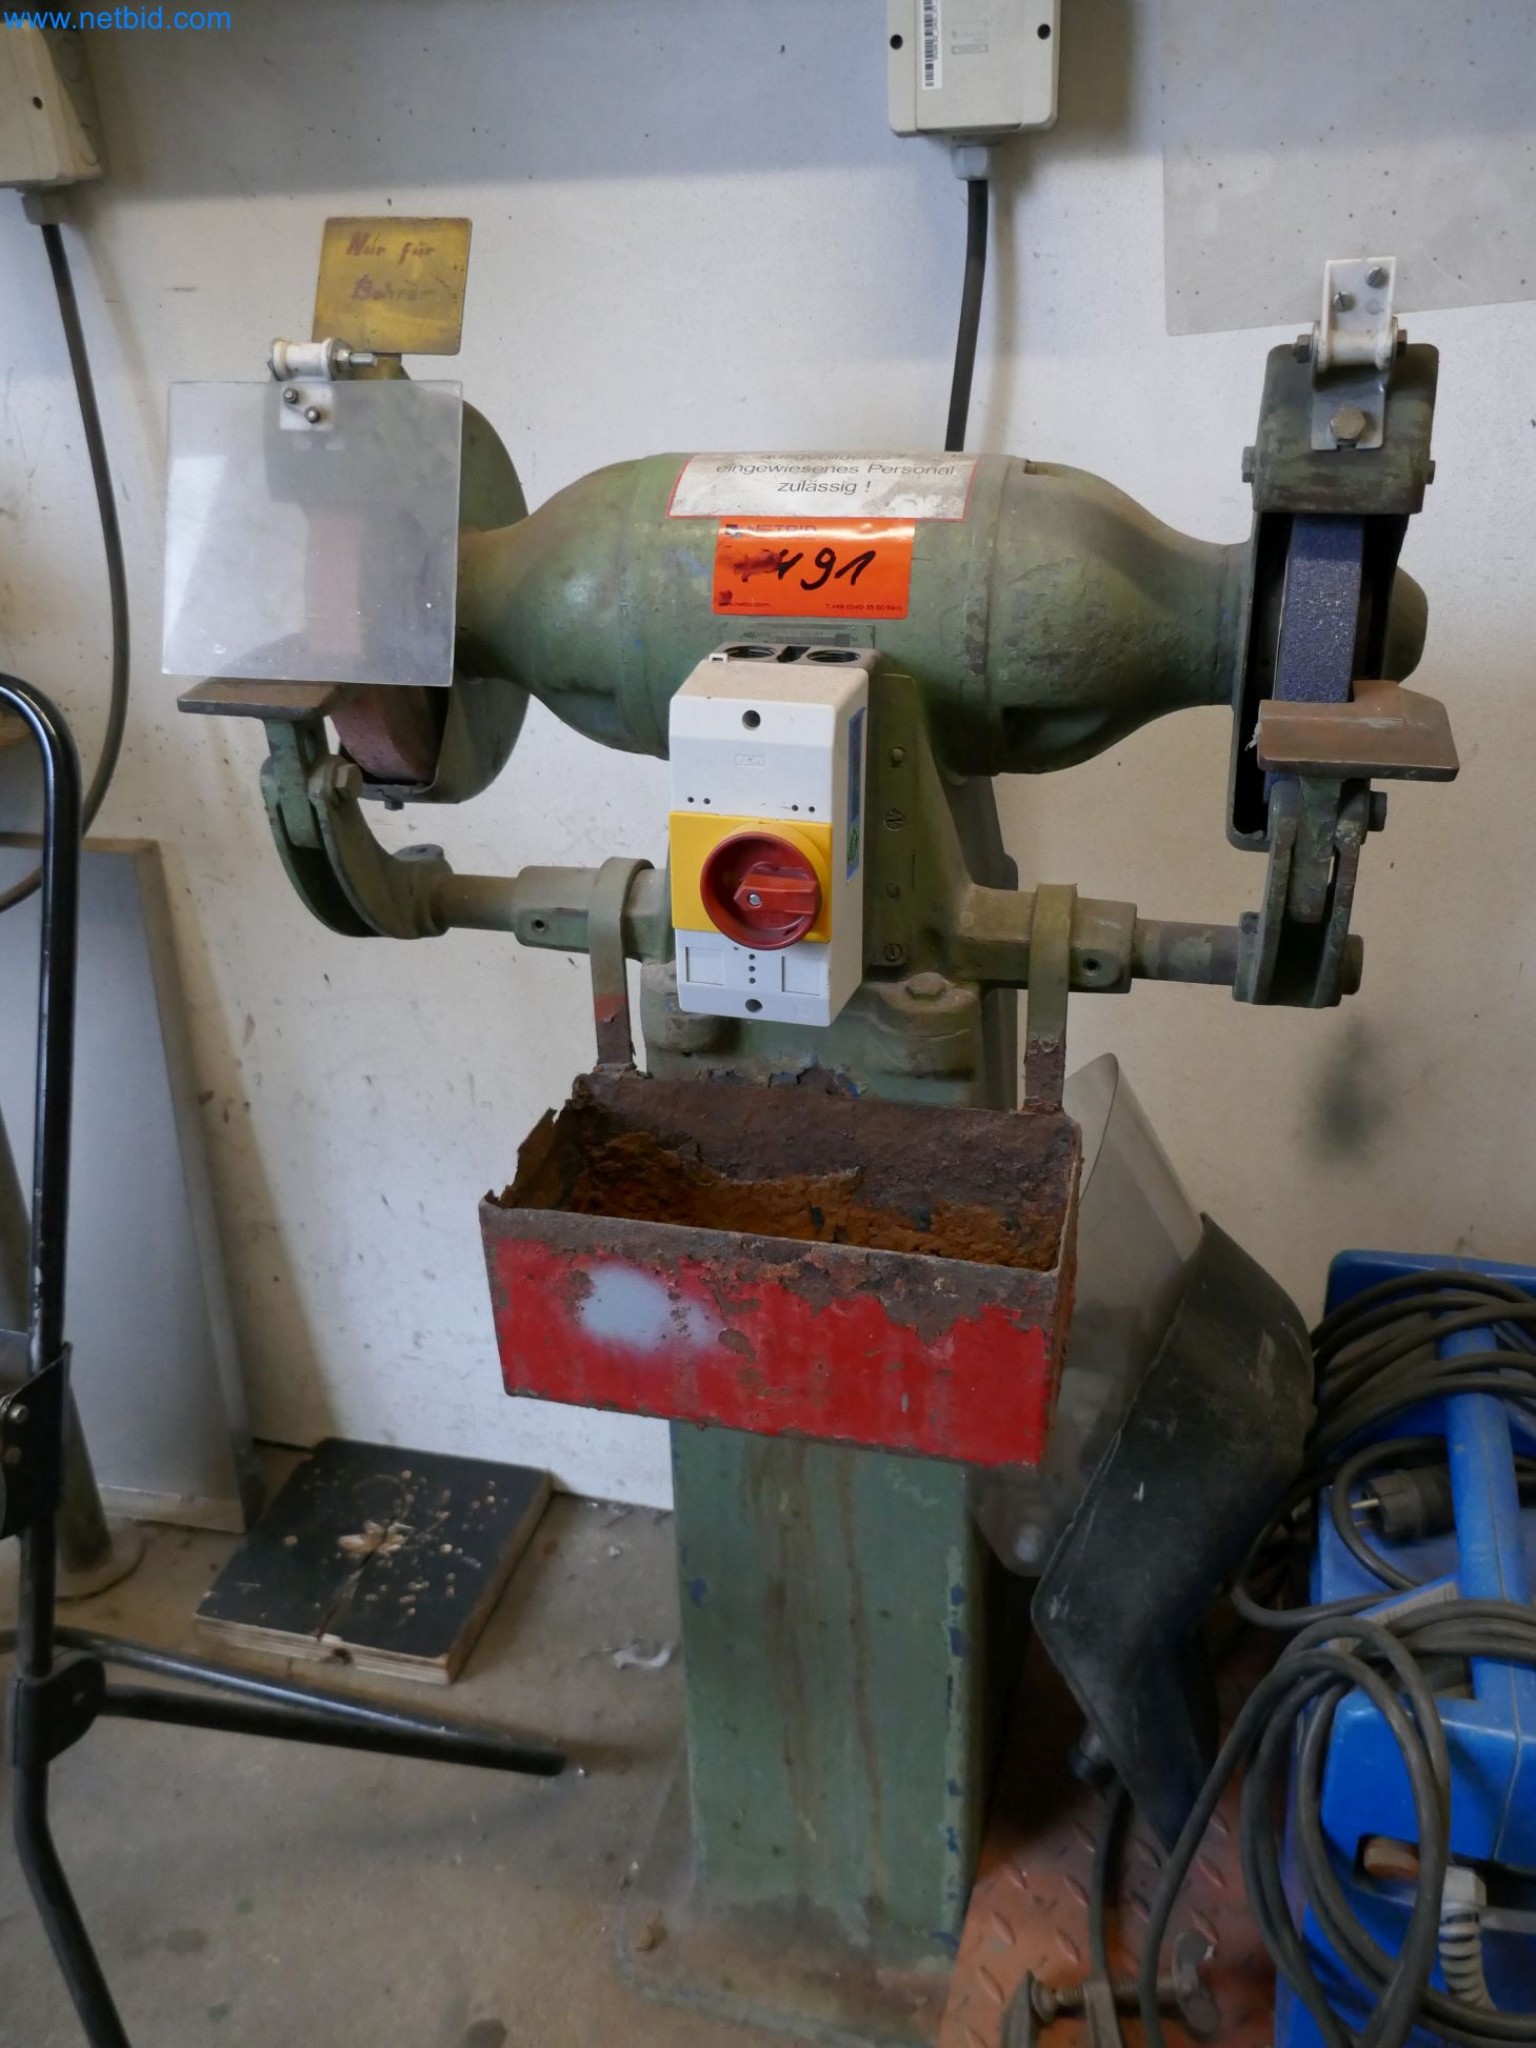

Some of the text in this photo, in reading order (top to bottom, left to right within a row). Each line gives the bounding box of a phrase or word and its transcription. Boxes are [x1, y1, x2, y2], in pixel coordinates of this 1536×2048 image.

[715, 461, 955, 476] eingewiesenes Personal
[776, 479, 857, 496] zulässig
